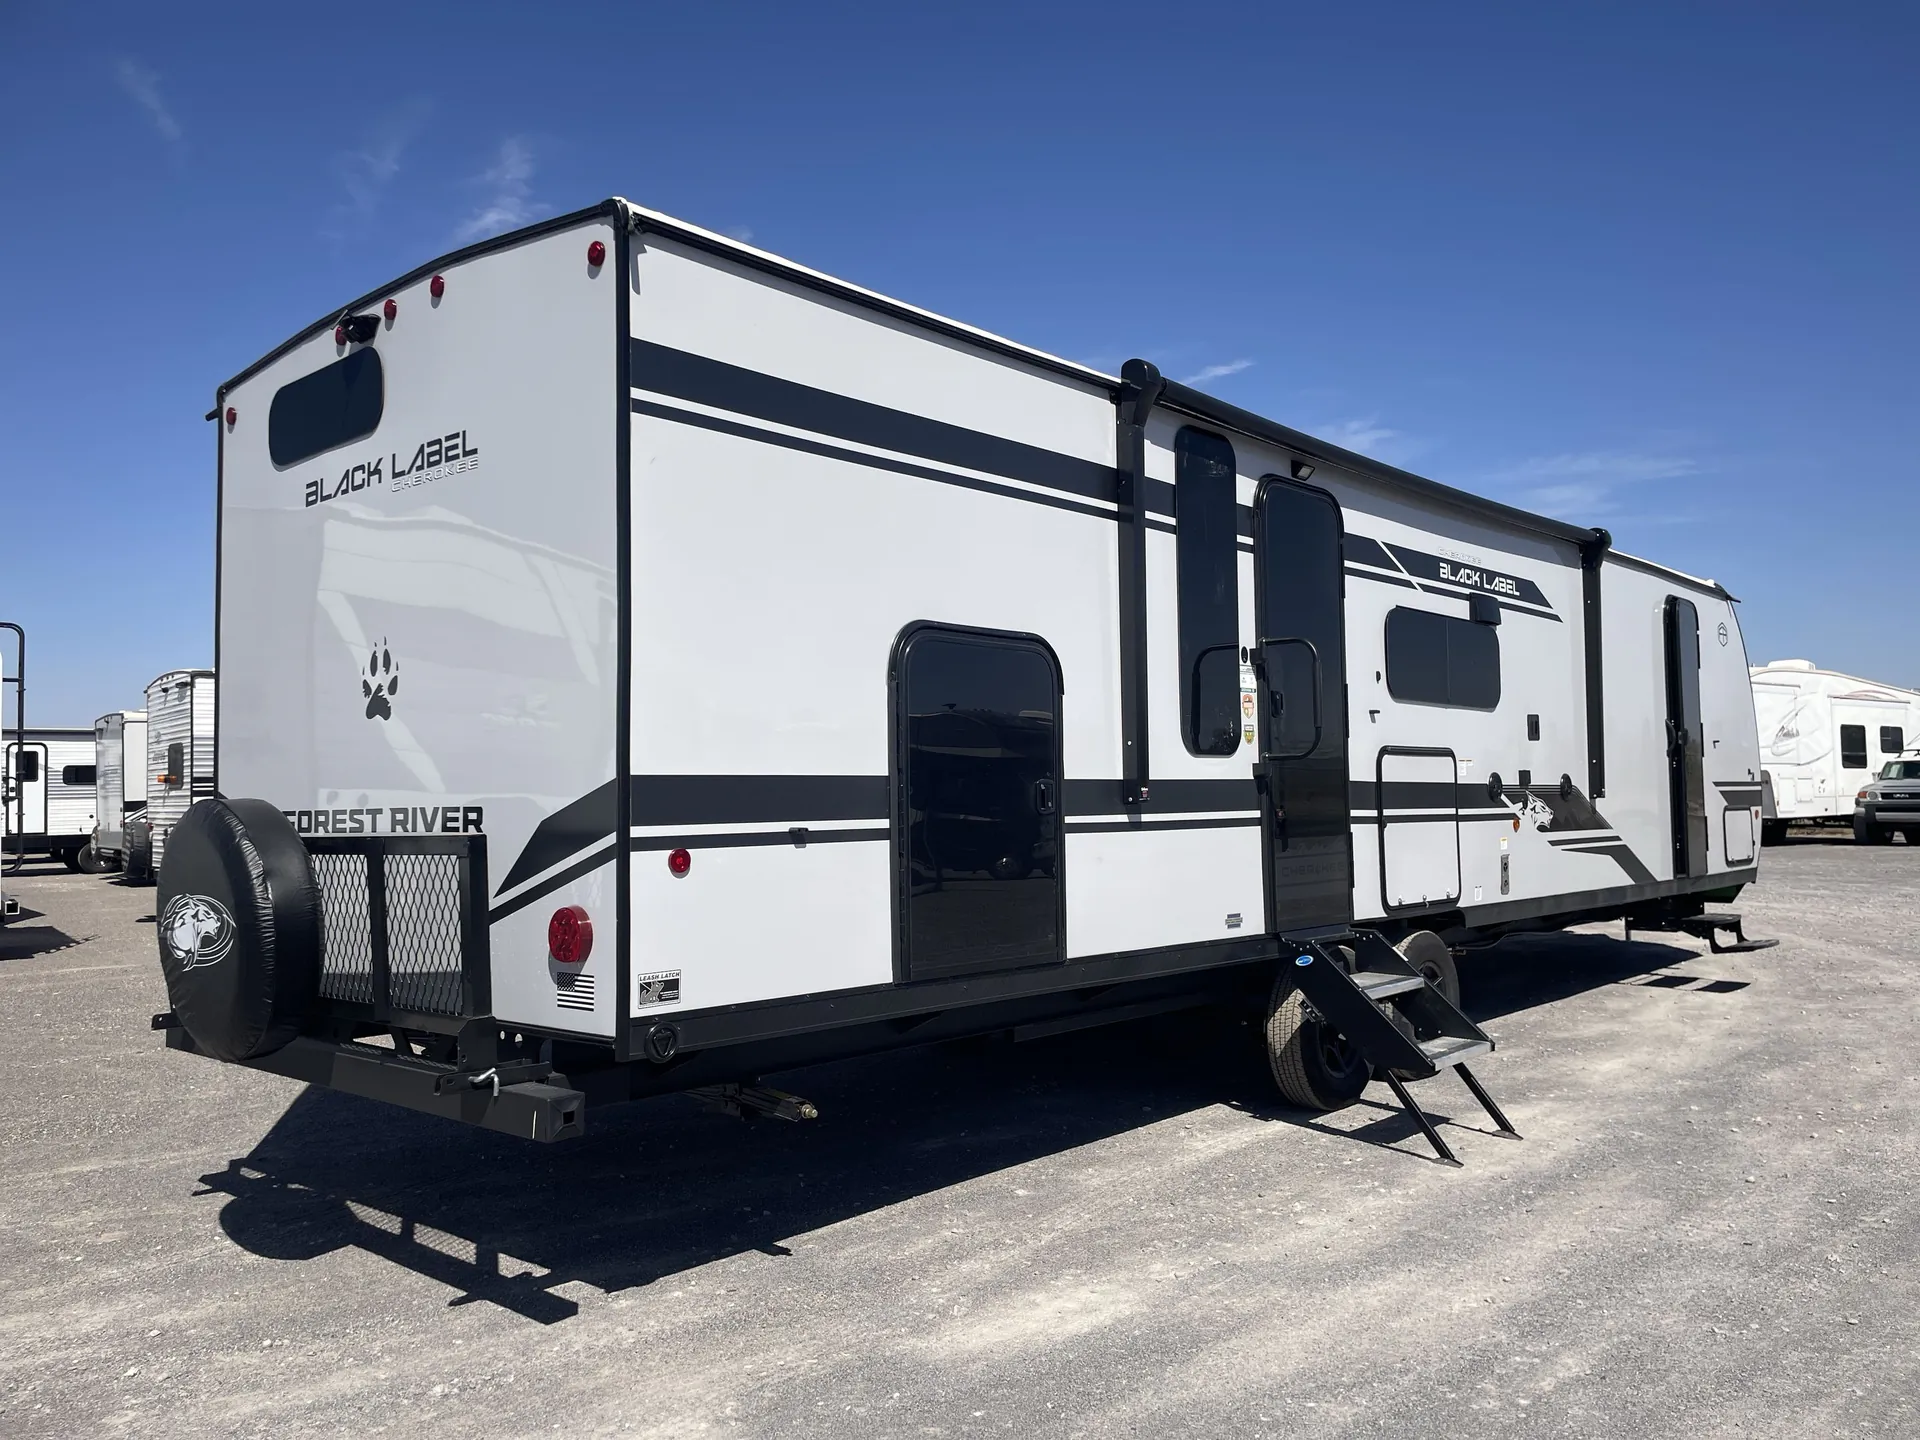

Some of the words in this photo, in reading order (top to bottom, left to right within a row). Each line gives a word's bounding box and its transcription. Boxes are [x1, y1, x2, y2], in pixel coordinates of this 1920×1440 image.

[305, 457, 383, 508] BLACK
[391, 430, 478, 480] LABEL
[391, 457, 479, 493] CHEROKEE
[1440, 562, 1481, 587] BLACK
[1483, 573, 1520, 596] LABEL
[389, 806, 484, 834] RIVER
[640, 974, 660, 982] LEASH
[661, 971, 680, 979] LATCH
